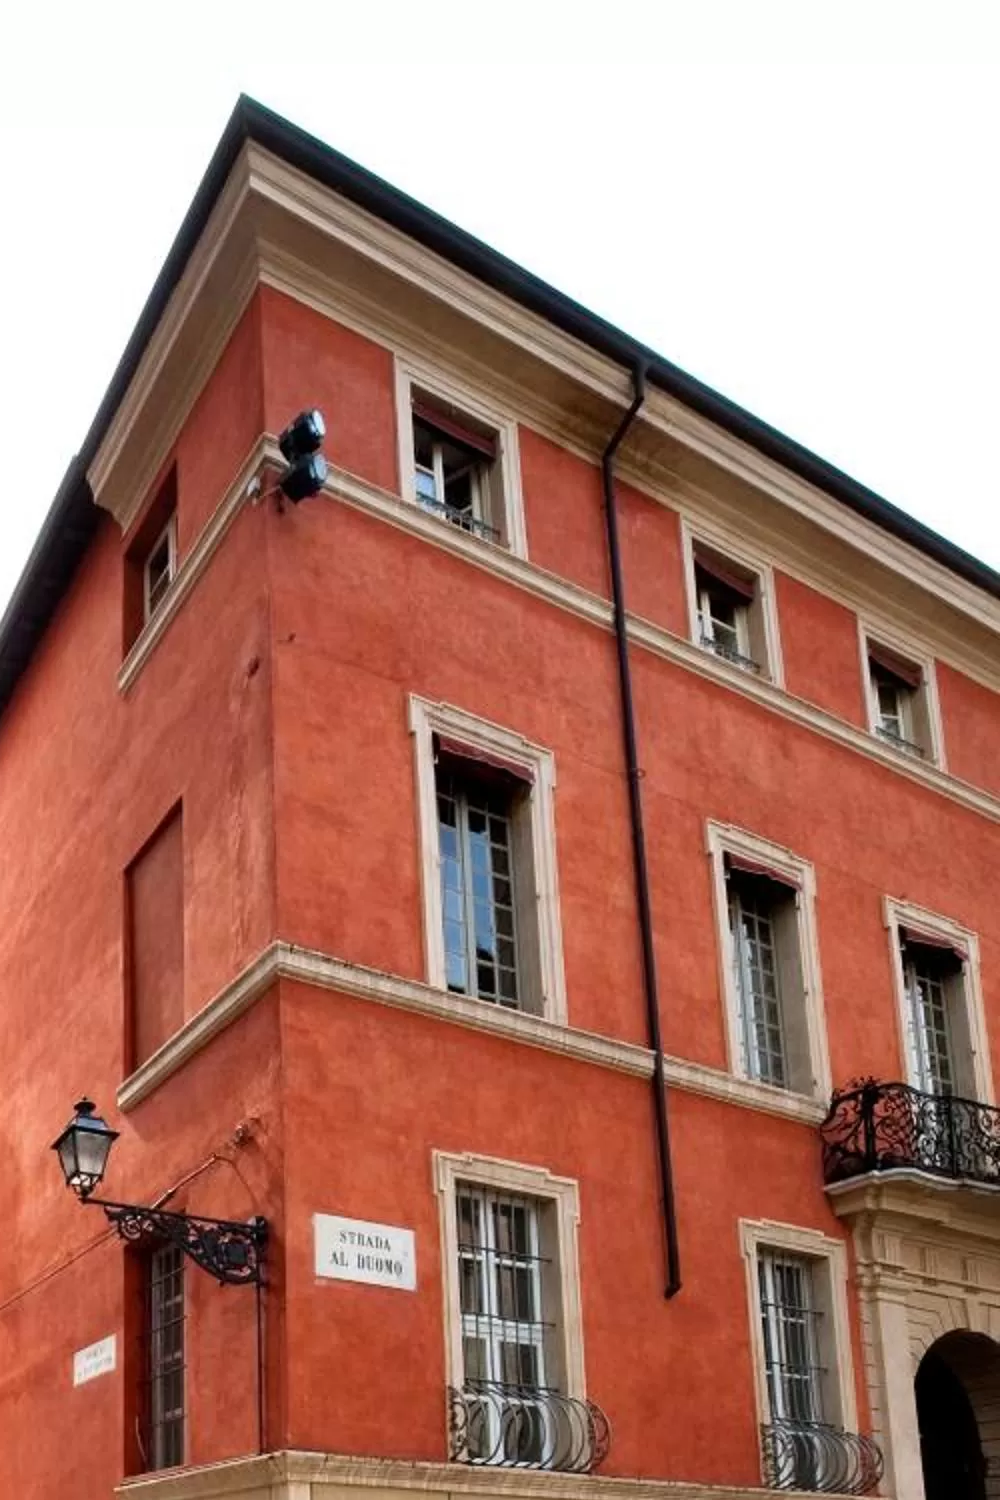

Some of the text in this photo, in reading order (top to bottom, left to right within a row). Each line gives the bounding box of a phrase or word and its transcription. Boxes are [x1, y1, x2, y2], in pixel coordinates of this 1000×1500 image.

[339, 1231, 391, 1252] STRADA
[330, 1250, 402, 1277] AL DUOMO
